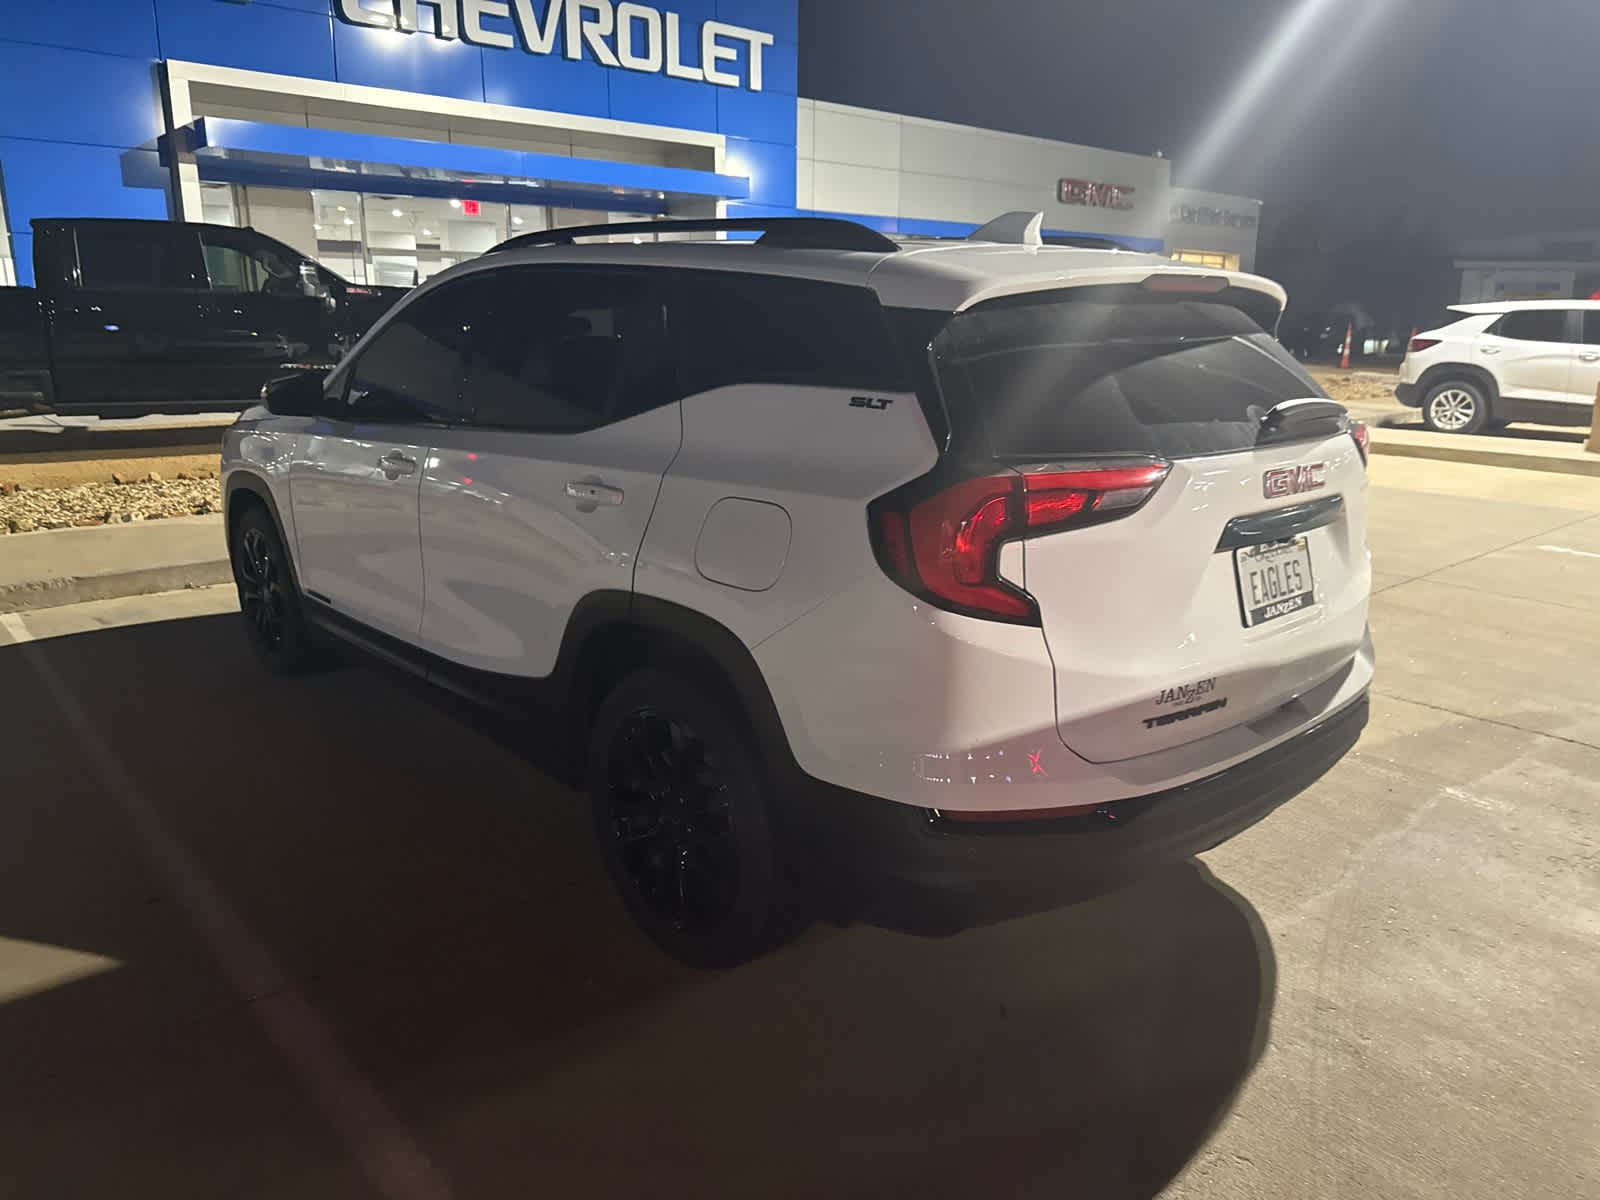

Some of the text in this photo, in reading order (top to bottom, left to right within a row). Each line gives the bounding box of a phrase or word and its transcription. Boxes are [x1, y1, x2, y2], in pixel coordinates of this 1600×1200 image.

[1057, 178, 1135, 210] GMC
[849, 396, 894, 410] SLT
[1263, 463, 1325, 499] GMC
[1250, 560, 1303, 604] EAGLES
[1263, 596, 1303, 618] JANZEN
[1155, 677, 1217, 705] JANZEN
